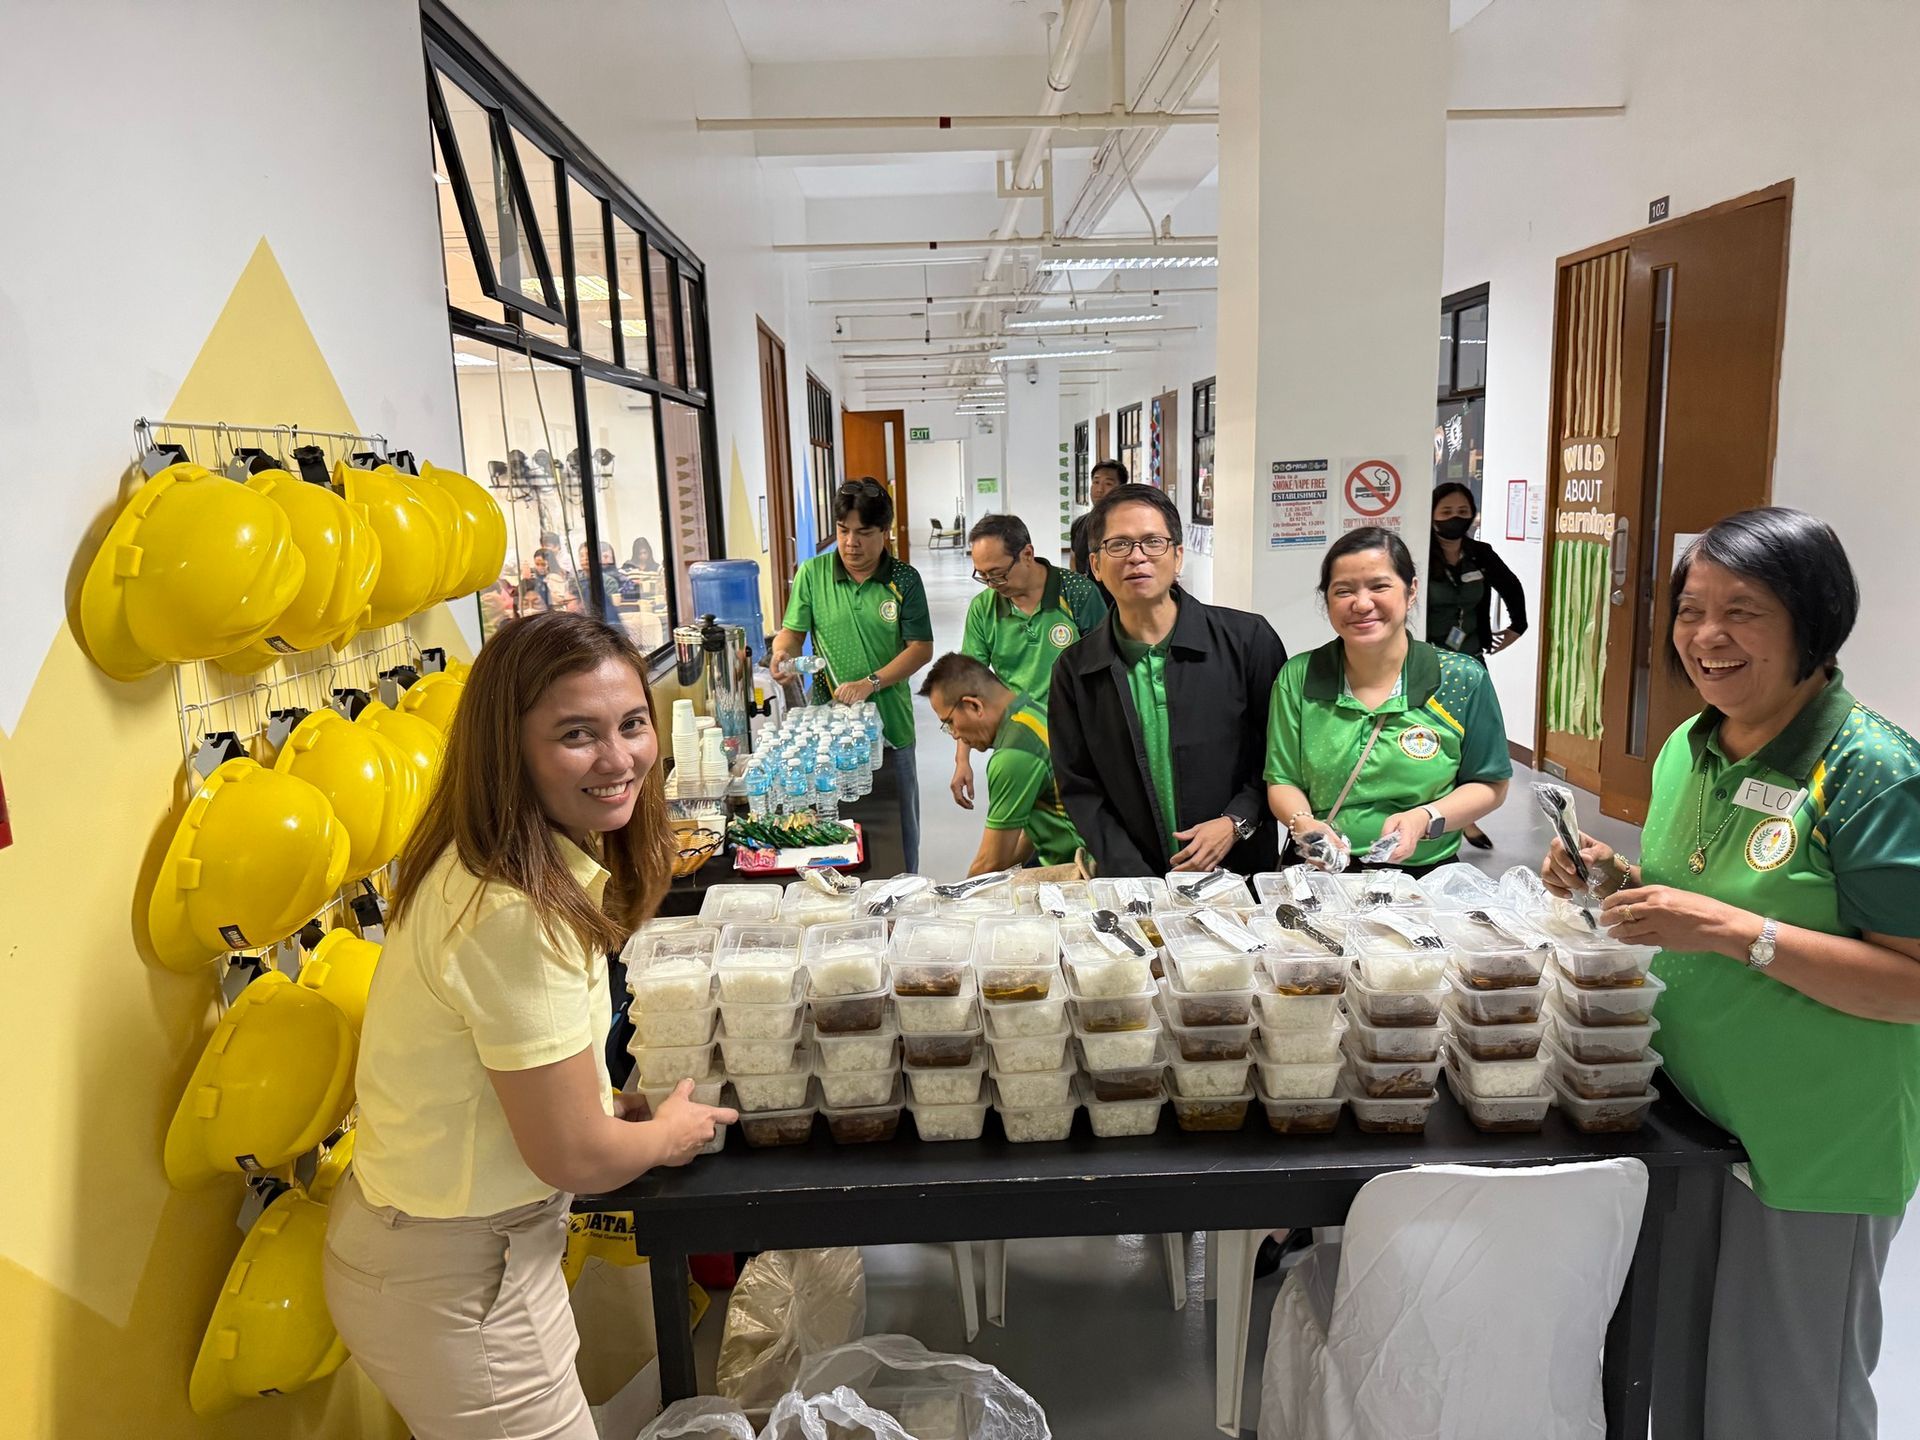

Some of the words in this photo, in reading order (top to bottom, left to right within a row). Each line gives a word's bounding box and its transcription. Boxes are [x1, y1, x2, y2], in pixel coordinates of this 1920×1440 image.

[1652, 202, 1665, 218] 102
[911, 429, 929, 439] EXIT
[1563, 444, 1605, 473] WILD
[1311, 478, 1326, 489] FREE
[1564, 479, 1603, 503] ABOUT
[1273, 491, 1326, 500] ESTABLISHMENT
[1555, 507, 1615, 541] learning
[1745, 781, 1792, 810] FLO
